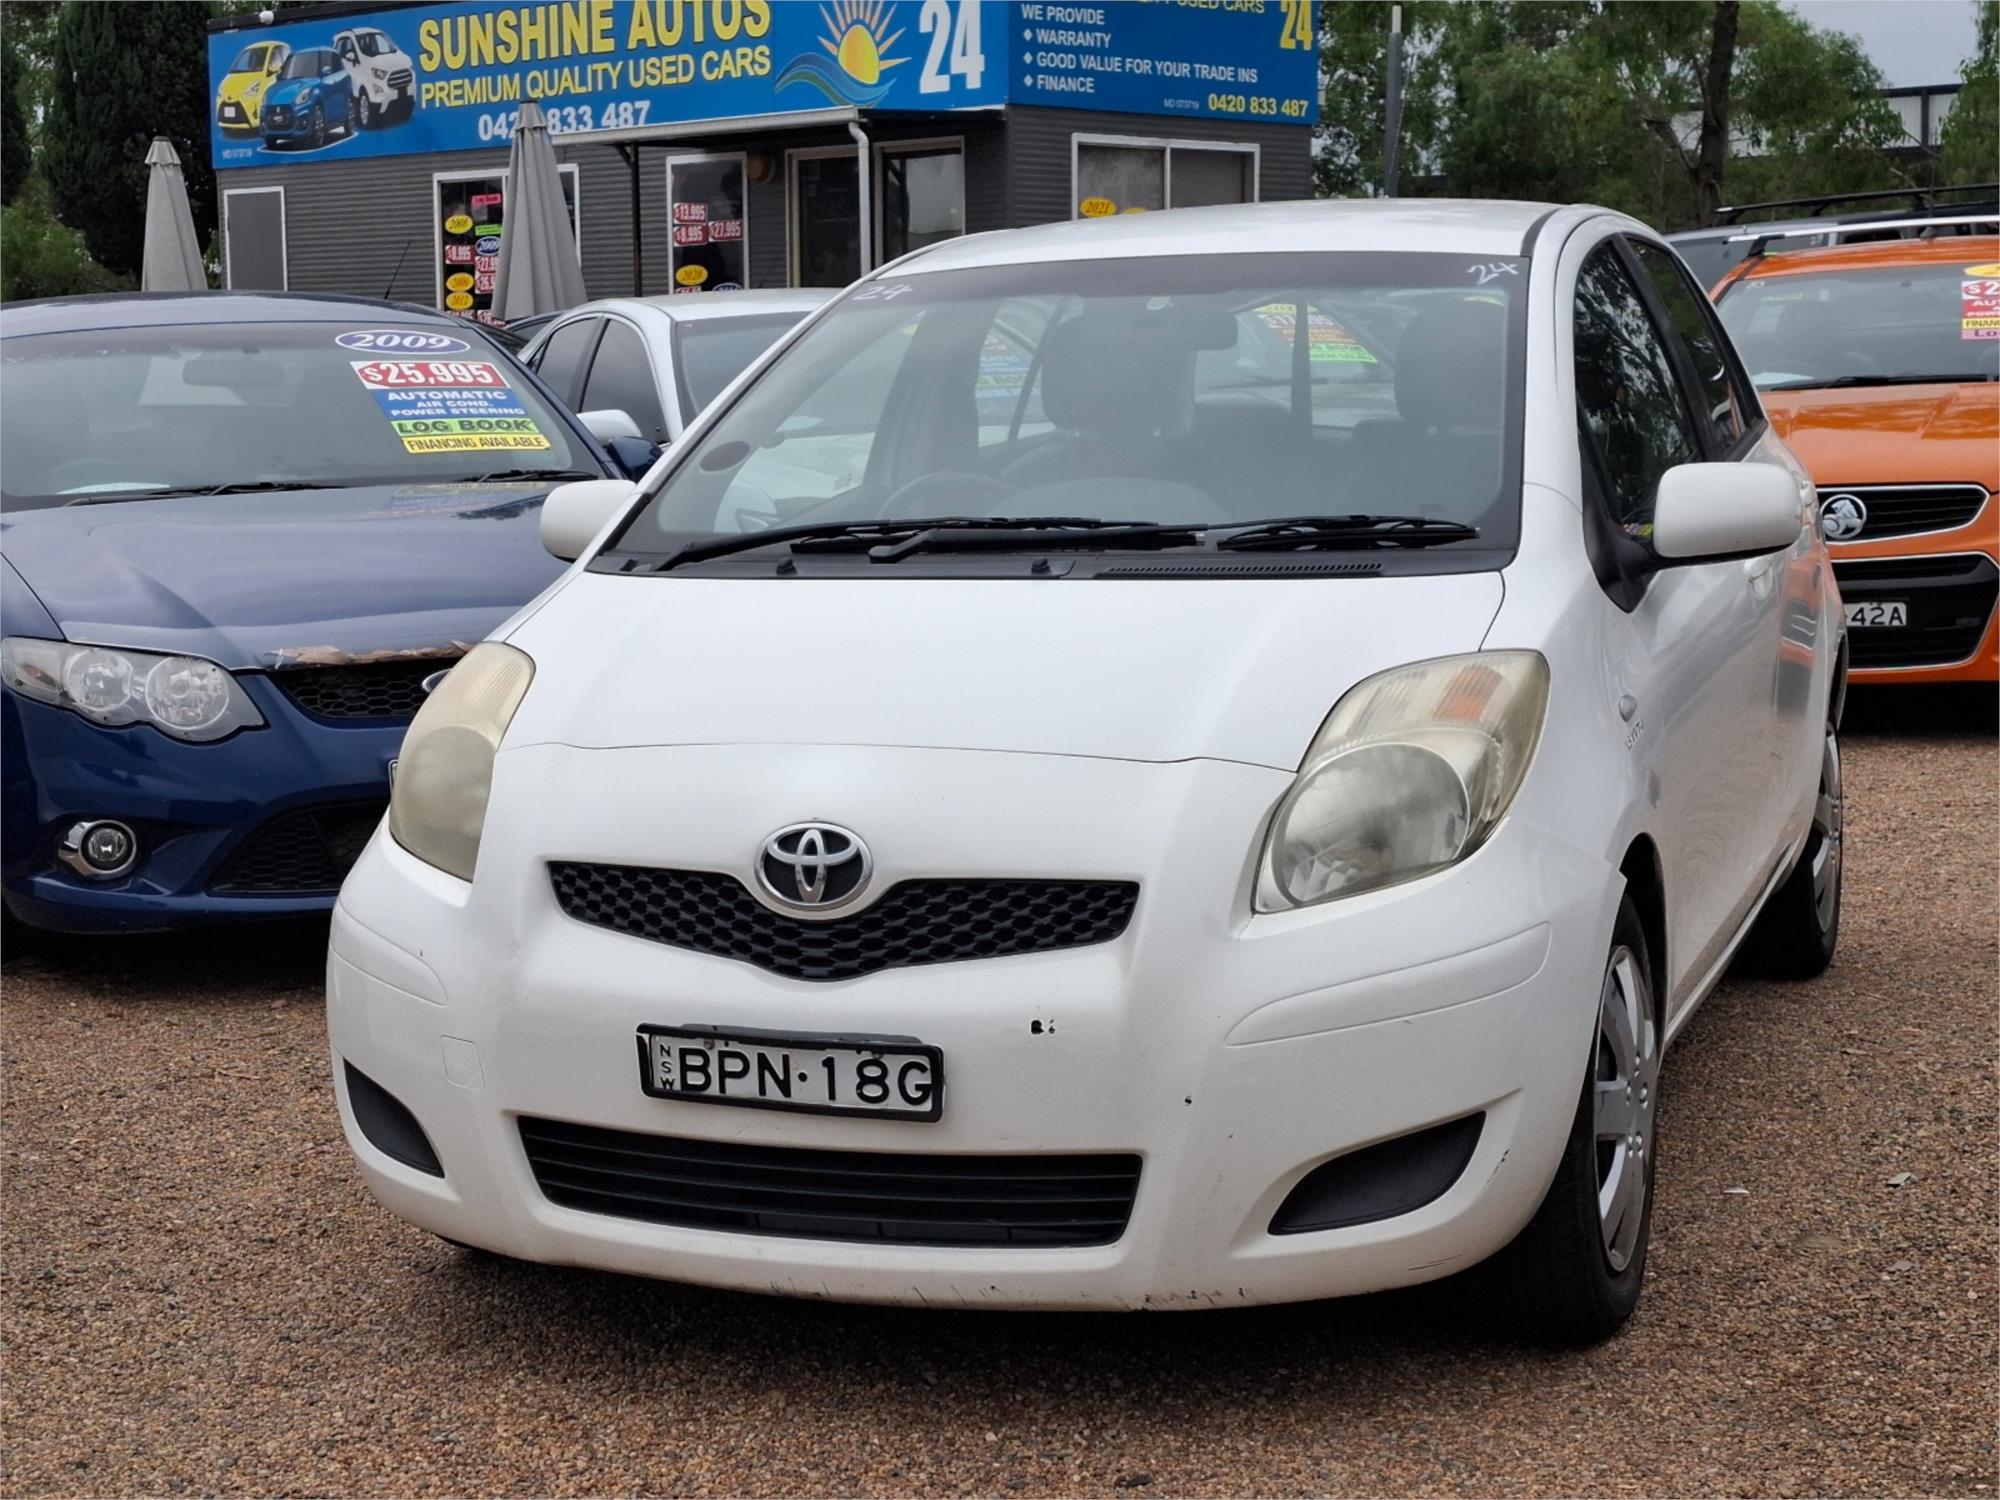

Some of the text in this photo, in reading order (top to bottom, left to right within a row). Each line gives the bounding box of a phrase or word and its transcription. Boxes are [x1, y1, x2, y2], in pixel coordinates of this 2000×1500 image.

[1021, 4, 1105, 25] WE PROVIDE
[1280, 0, 1313, 50] 24
[419, 0, 771, 72] SUNSHINE AUTOS
[1036, 28, 1112, 48] WARRANTY
[919, 0, 985, 94] 24
[421, 45, 771, 109] PREMIUM QUALITY USED CARS
[1036, 51, 1258, 83] GOOD VALUE FOR YOUR TRADE INS
[1037, 74, 1095, 93] FINANCE
[1208, 93, 1310, 117] 0420 833 487
[478, 100, 651, 141] 042 833 487
[350, 333, 451, 349] 2009
[362, 362, 495, 384] $25,995
[388, 390, 508, 401] AUTOMATIC
[390, 407, 526, 417] POWER STEERING
[397, 420, 533, 434] LOG BOOK
[406, 436, 544, 450] FINANCING AVAILABLE
